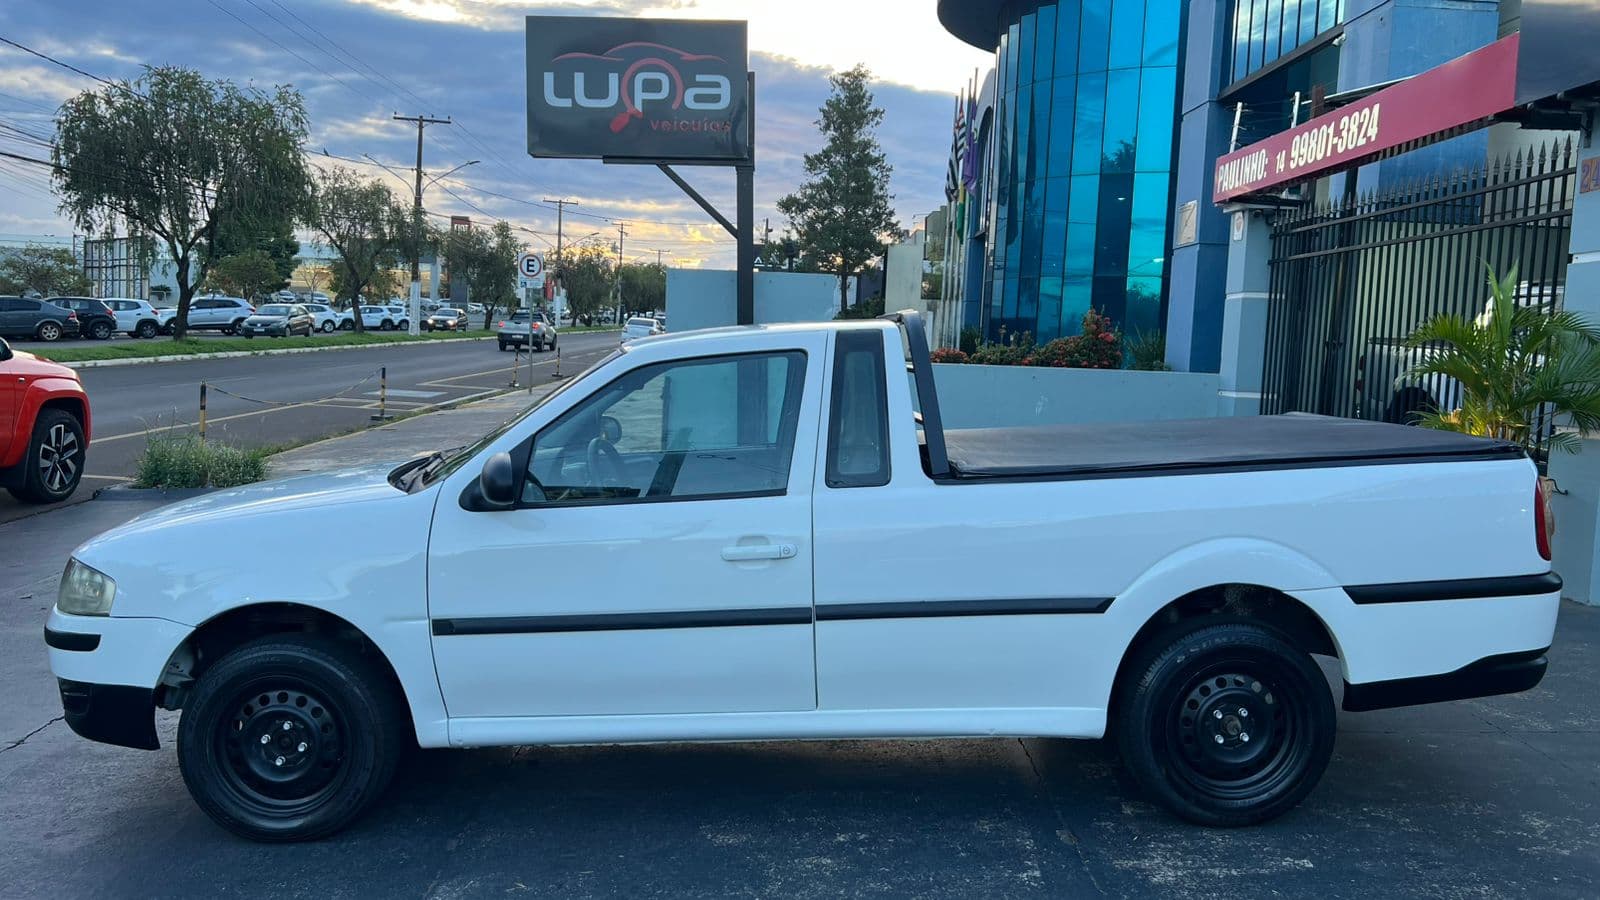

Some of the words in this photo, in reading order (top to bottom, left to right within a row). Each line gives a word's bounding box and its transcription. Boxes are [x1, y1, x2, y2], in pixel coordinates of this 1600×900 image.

[1217, 149, 1268, 193] PAULINHO:
[1275, 150, 1286, 174] 14
[1290, 103, 1380, 169] 99801-3824
[526, 259, 535, 272] E
